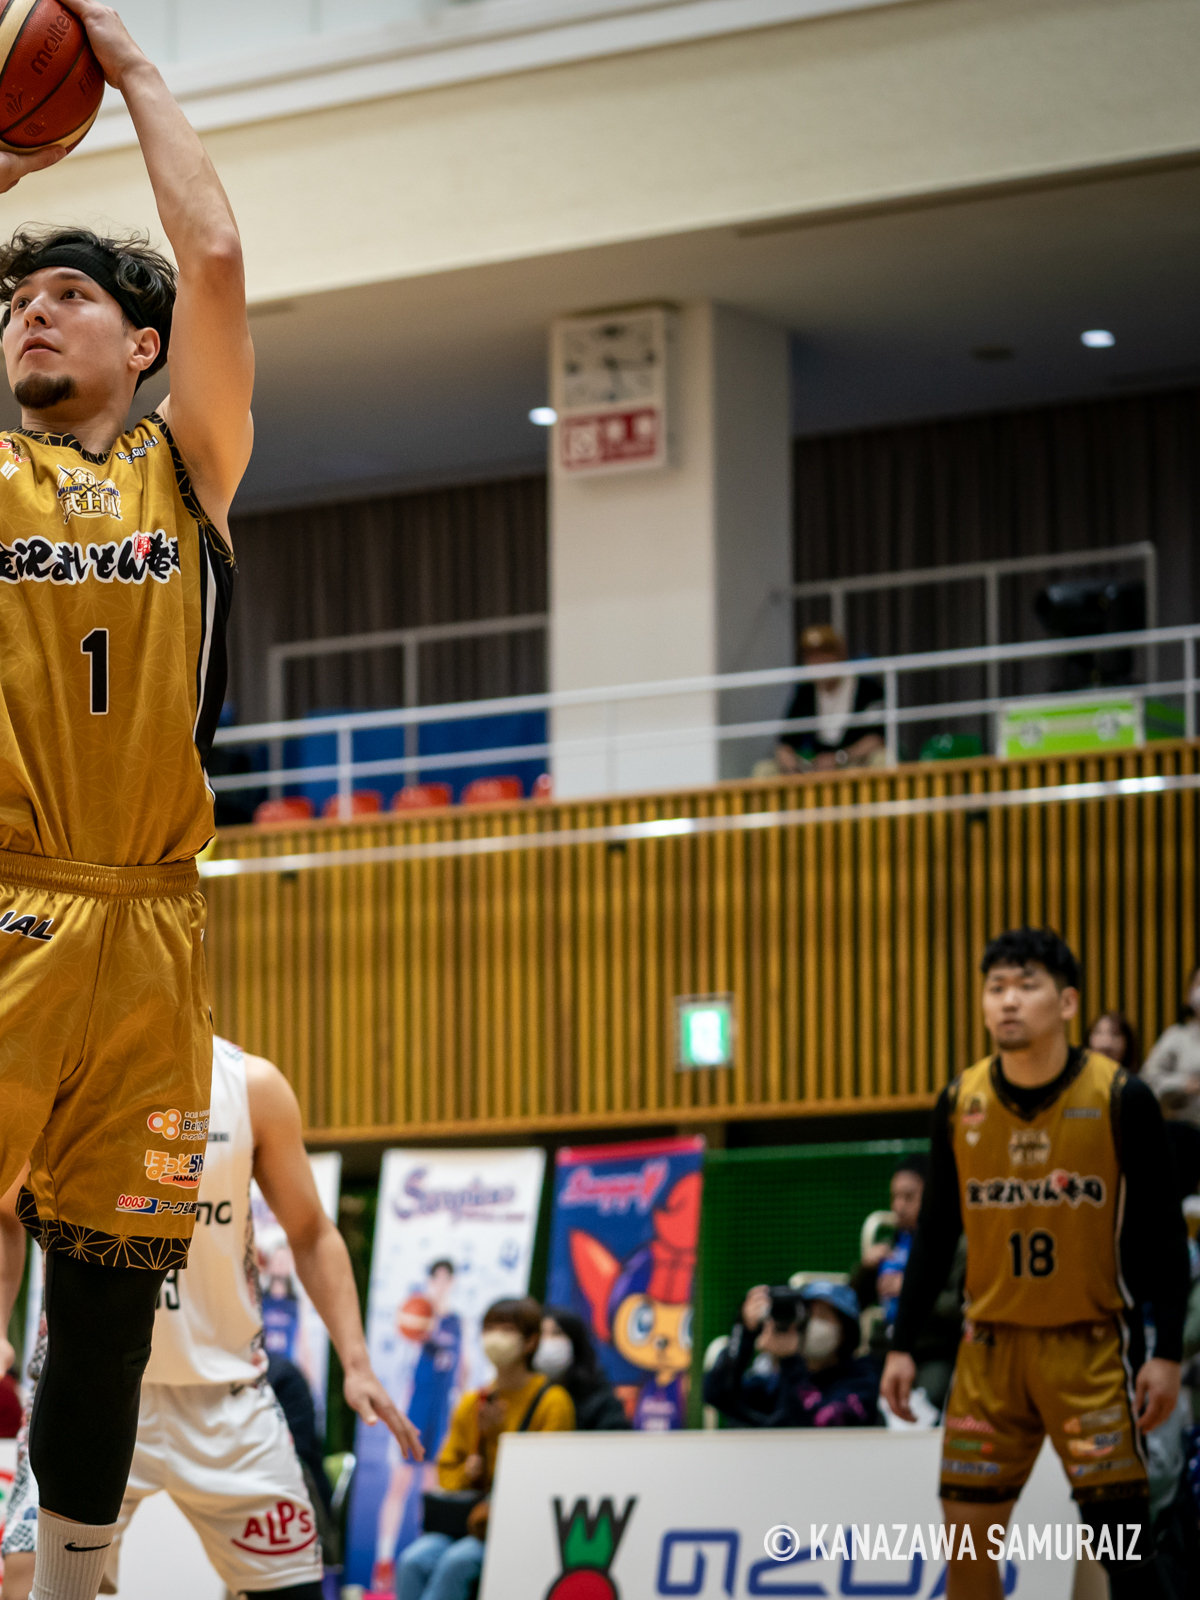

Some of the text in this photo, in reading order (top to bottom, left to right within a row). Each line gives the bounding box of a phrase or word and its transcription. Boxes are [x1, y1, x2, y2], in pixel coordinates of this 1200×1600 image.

[81, 629, 109, 715] 1
[117, 1194, 146, 1208] 0003
[1010, 1231, 1055, 1277] 18
[243, 1501, 311, 1546] ALPS
